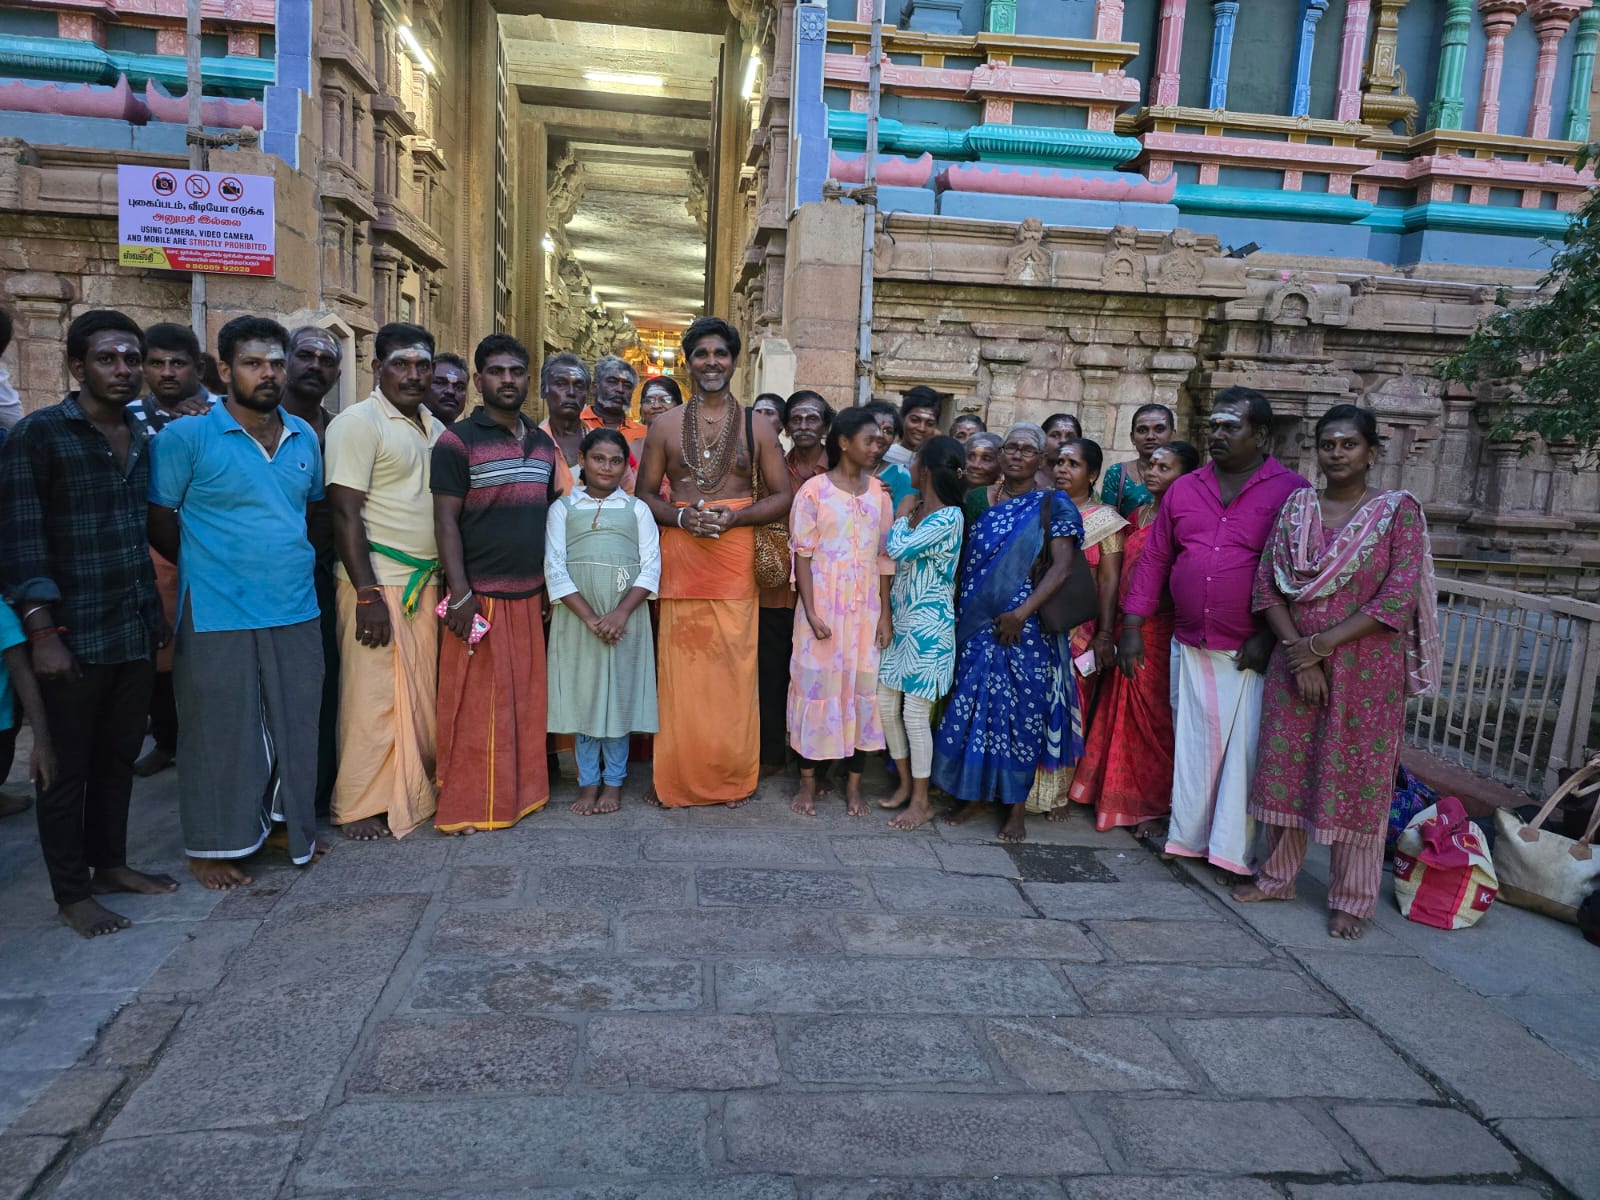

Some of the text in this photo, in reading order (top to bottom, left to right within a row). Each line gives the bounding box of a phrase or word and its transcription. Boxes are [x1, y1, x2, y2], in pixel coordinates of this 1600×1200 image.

[128, 198, 265, 216] புகைப்படம், வீடியோ எடுக்க
[152, 213, 242, 227] அனுமதி இல்லை
[141, 226, 254, 241] USING CAMERA, VIDEO CAMERA
[127, 234, 267, 251] AND MOBILE ARE STRICTLY PROHIBITED
